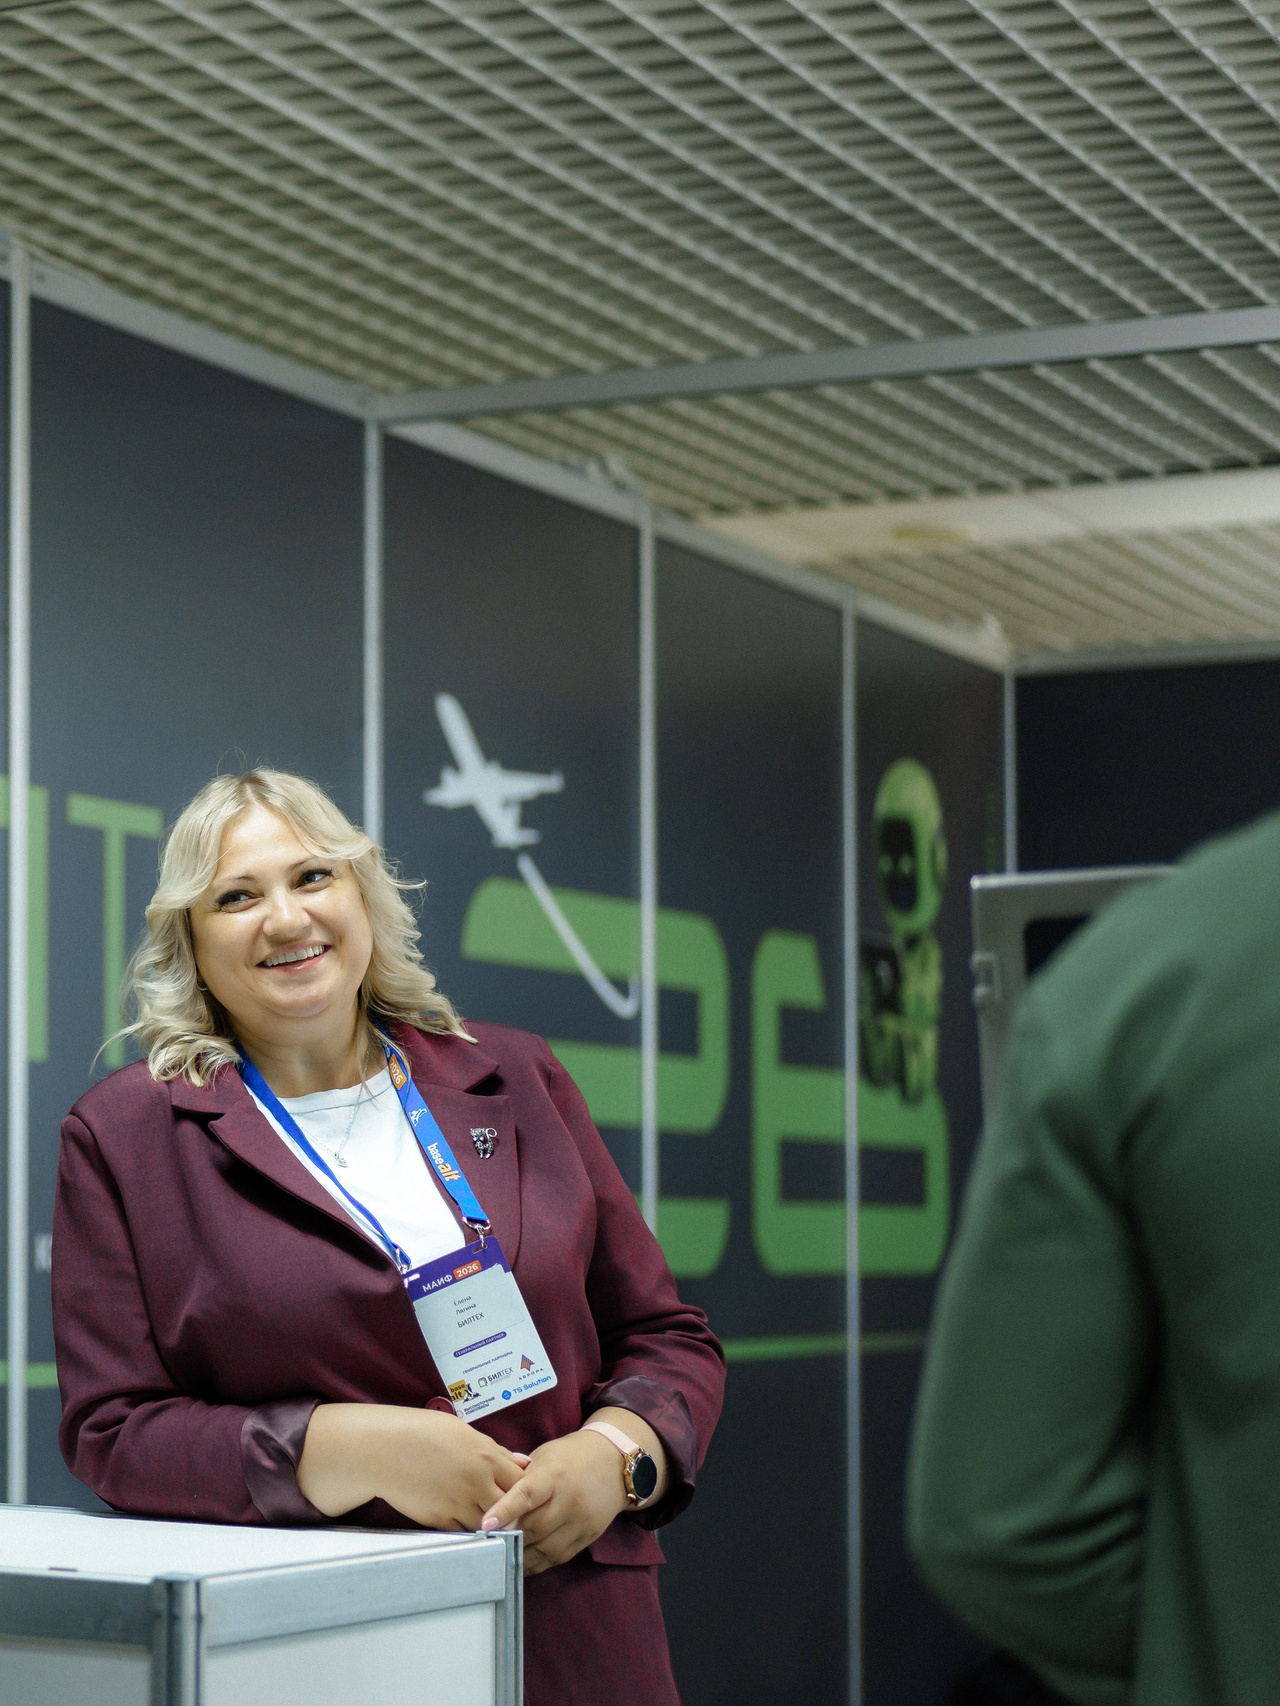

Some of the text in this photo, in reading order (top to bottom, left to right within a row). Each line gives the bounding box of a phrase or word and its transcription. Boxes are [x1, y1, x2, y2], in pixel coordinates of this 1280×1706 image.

[422, 1263, 479, 1293] МАИФ 2026
[457, 1312, 485, 1328] БИЛТЕХ
[487, 1367, 514, 1381] БИЛТЕХ
[512, 1385, 523, 1395] TS
[524, 1375, 552, 1391] Solution
